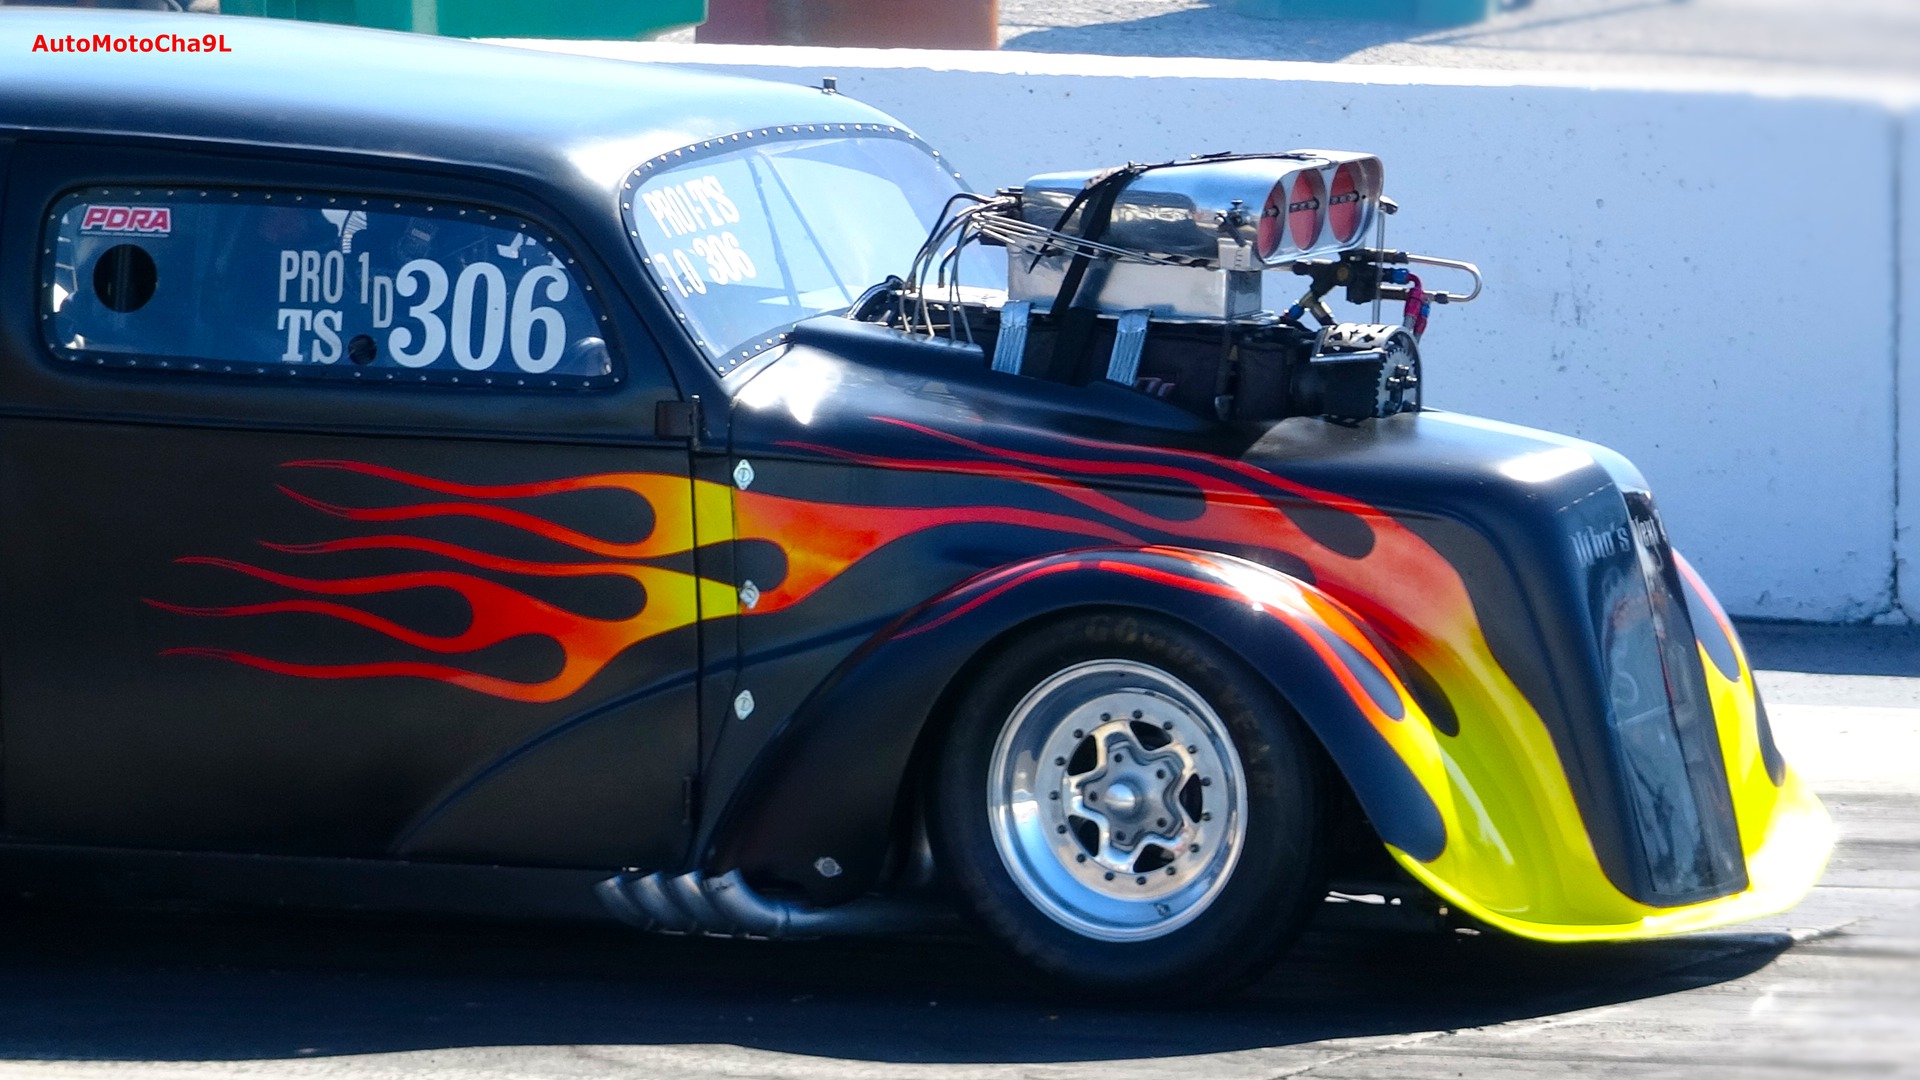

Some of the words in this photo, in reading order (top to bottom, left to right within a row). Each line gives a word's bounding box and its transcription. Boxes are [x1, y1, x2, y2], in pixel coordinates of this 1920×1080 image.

[81, 206, 171, 233] PDRA
[692, 231, 758, 286] 306
[277, 308, 343, 364] TS
[279, 250, 345, 304] PRO
[388, 258, 569, 374] 306
